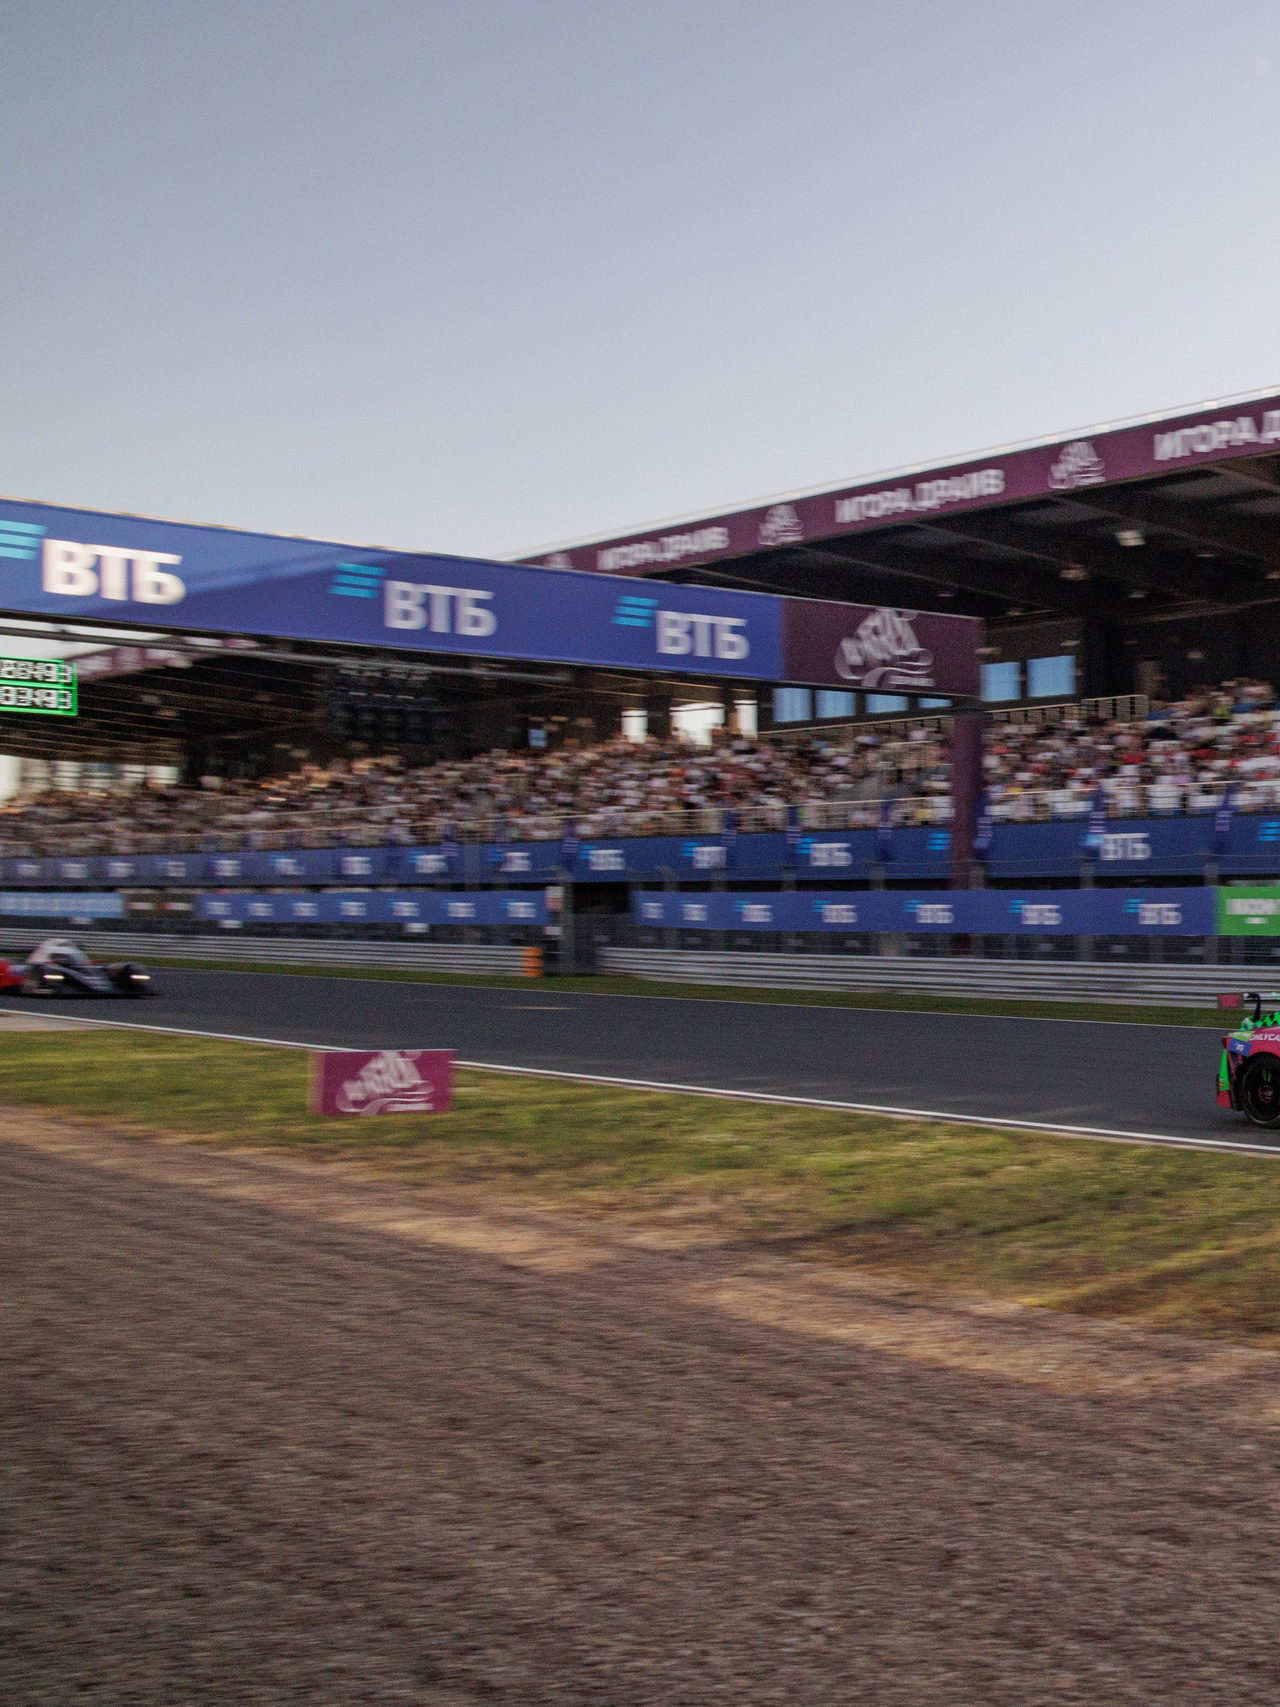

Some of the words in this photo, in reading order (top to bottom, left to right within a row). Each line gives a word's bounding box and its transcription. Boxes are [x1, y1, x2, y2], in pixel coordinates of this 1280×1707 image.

[41, 538, 187, 606] ВТБ
[384, 580, 498, 637] ВТБ
[656, 611, 751, 660] ВТБ
